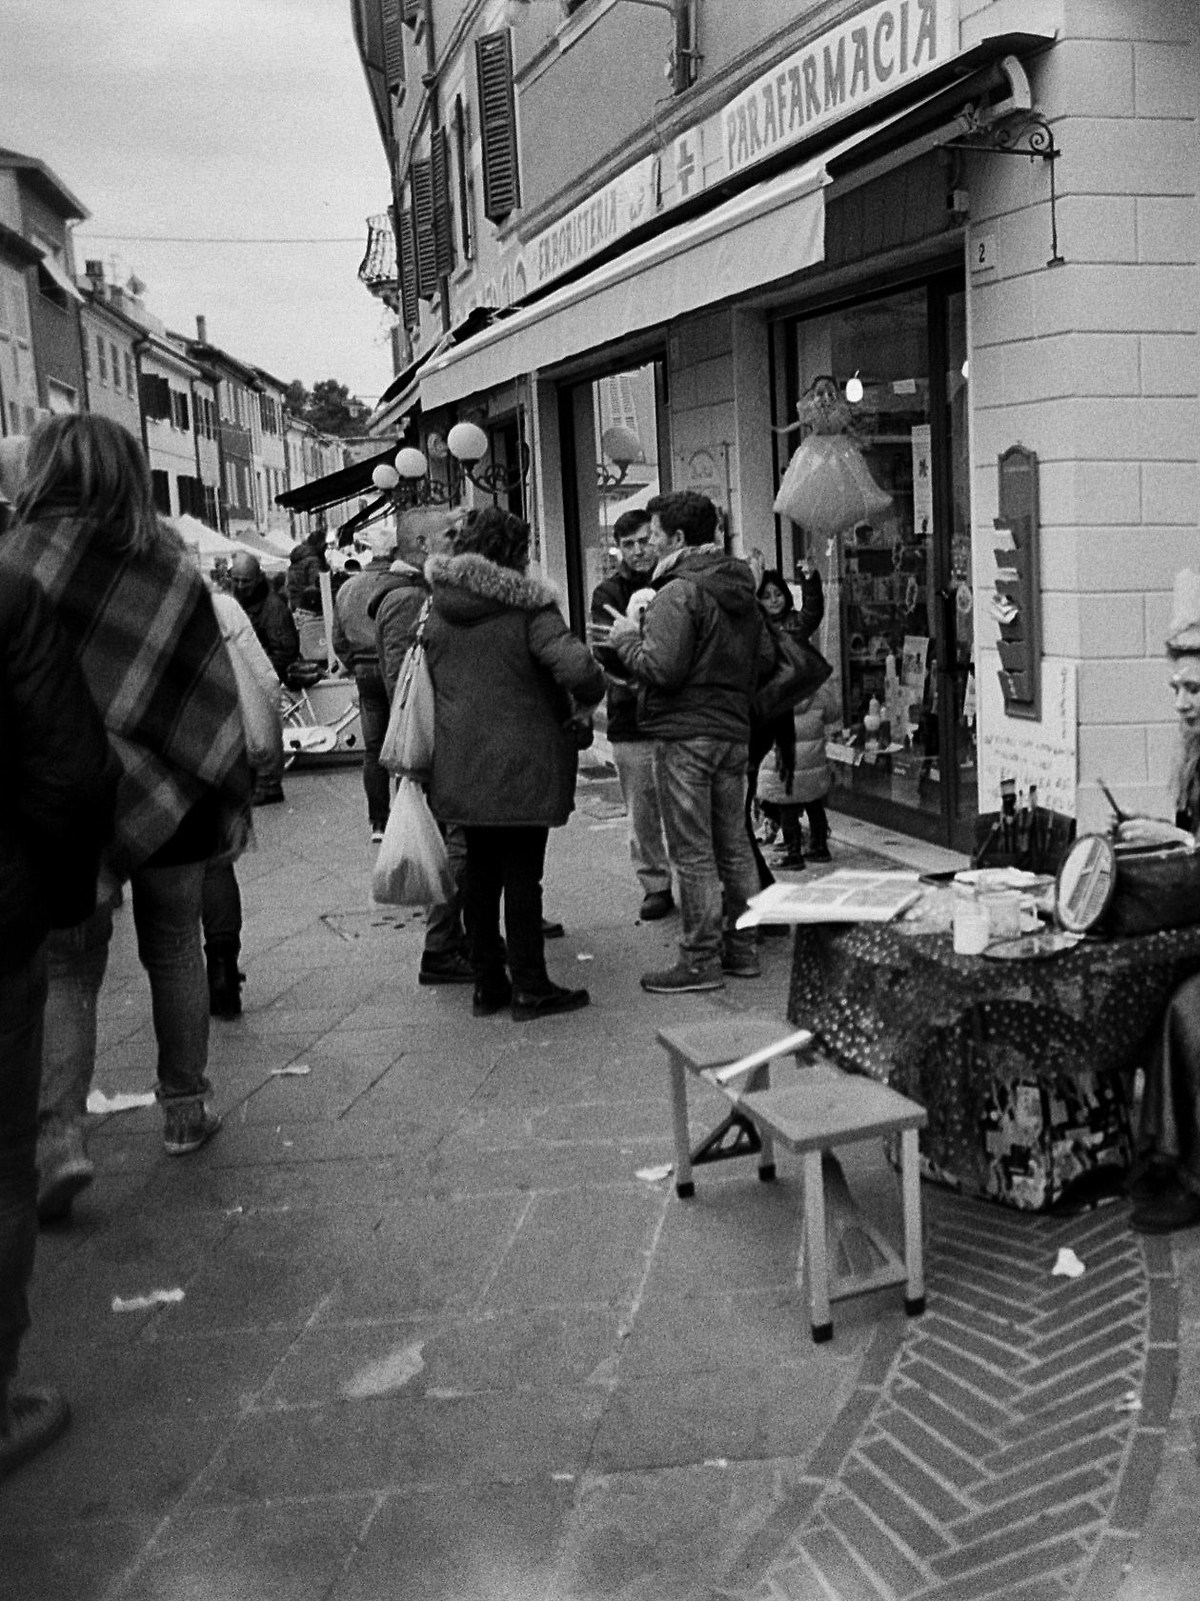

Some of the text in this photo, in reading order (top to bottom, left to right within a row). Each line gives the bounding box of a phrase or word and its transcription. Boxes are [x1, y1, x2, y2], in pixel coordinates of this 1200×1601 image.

[727, 0, 937, 170] PARAFARMACIA
[538, 189, 618, 281] ERBORISTERIA
[978, 242, 986, 263] 2
